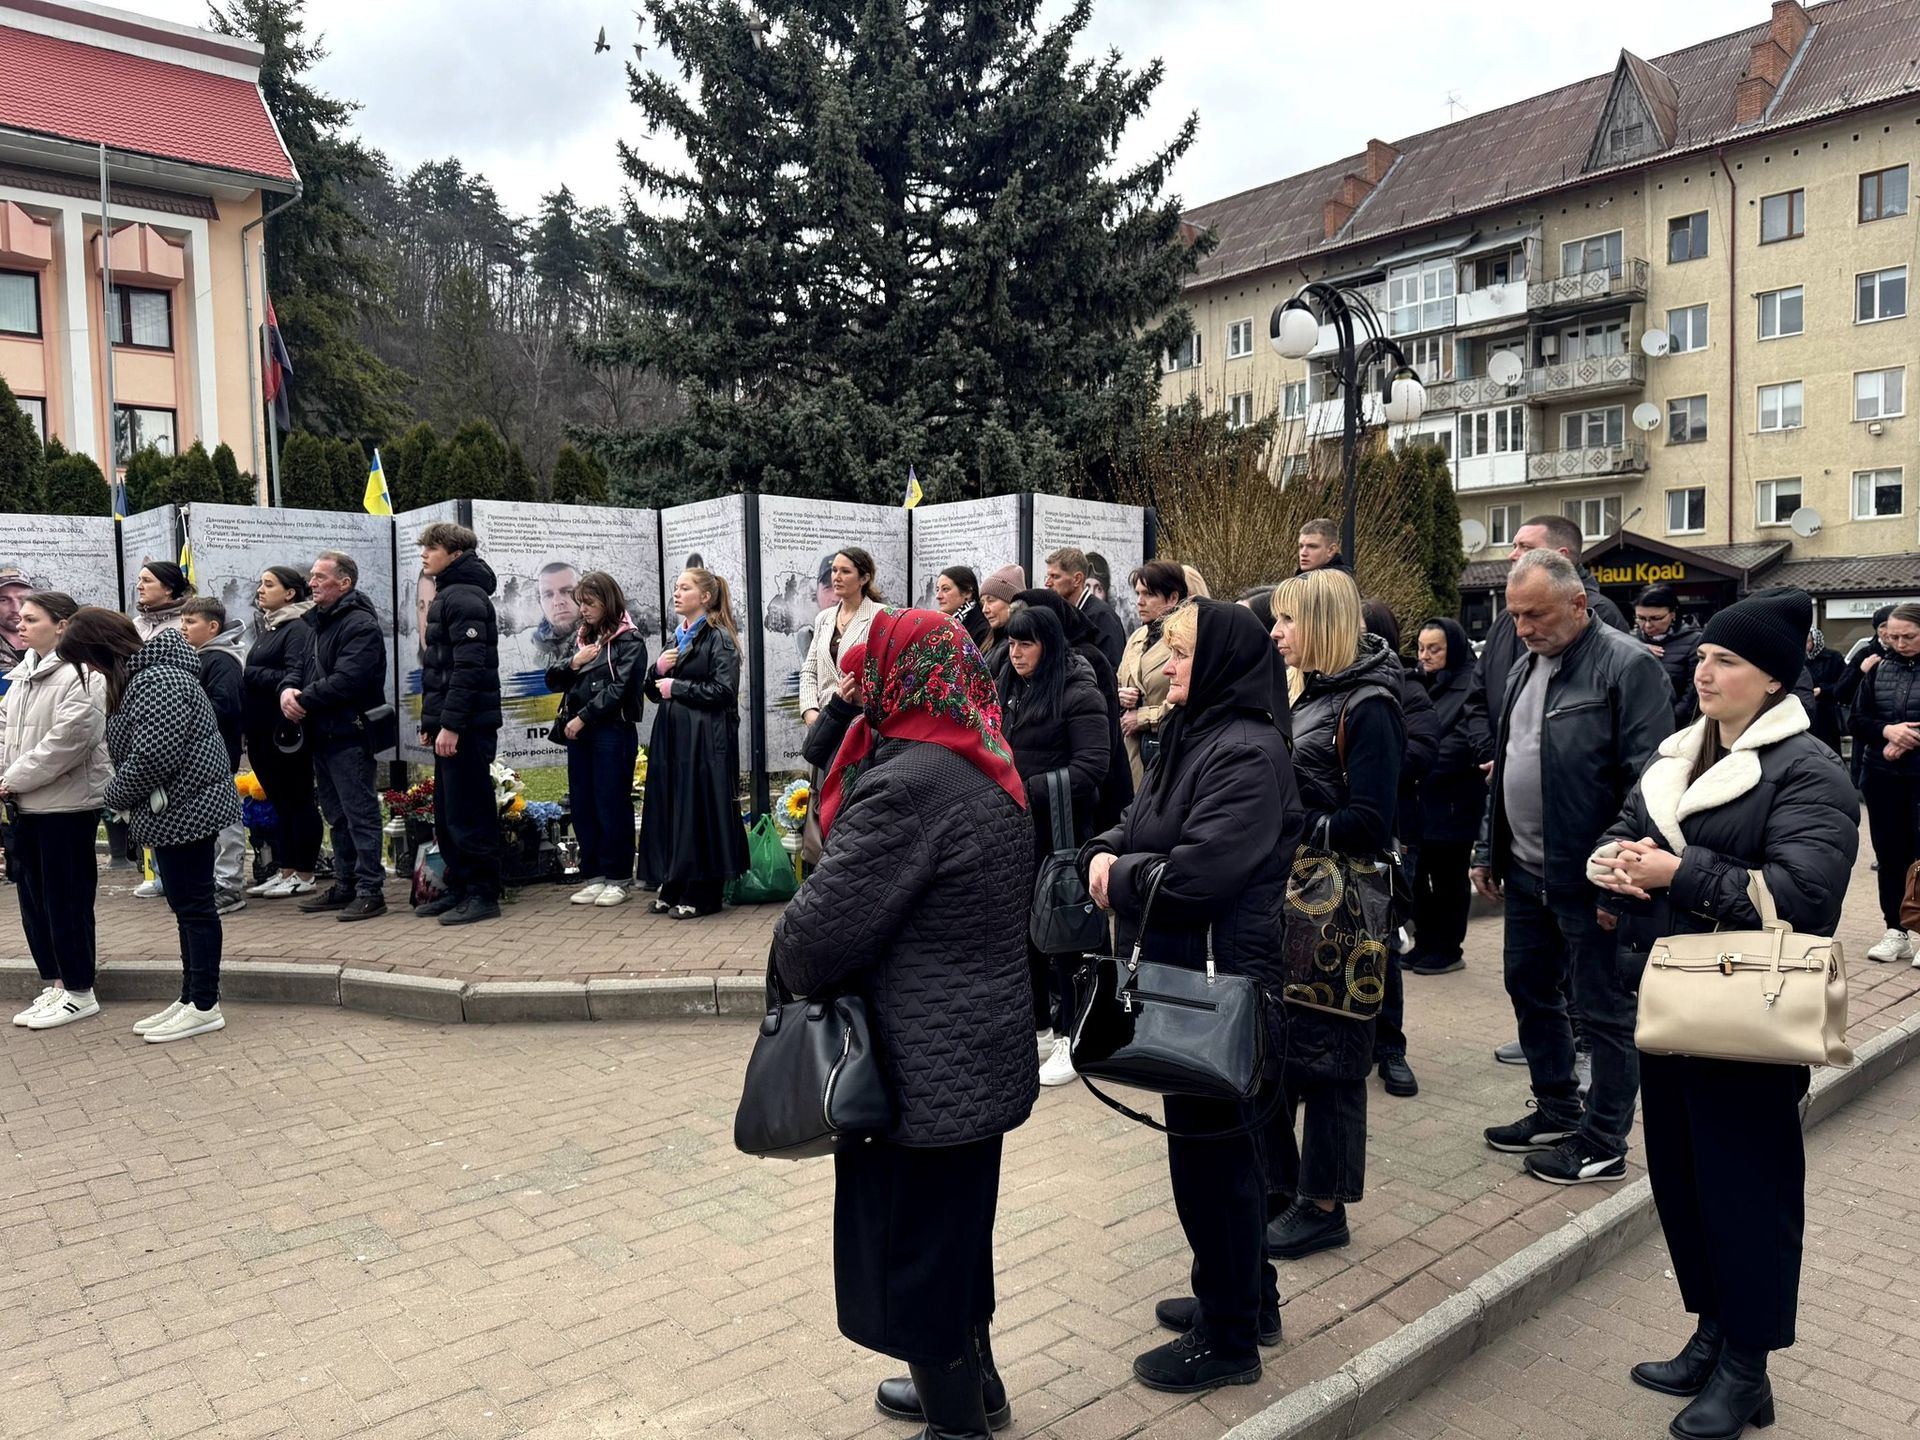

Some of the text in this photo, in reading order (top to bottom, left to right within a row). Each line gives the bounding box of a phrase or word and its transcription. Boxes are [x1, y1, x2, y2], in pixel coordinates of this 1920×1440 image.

[1590, 561, 1685, 585] Наш Край
[526, 727, 550, 739] ПР
[530, 747, 568, 758] російськ
[1321, 922, 1361, 948] Circl
